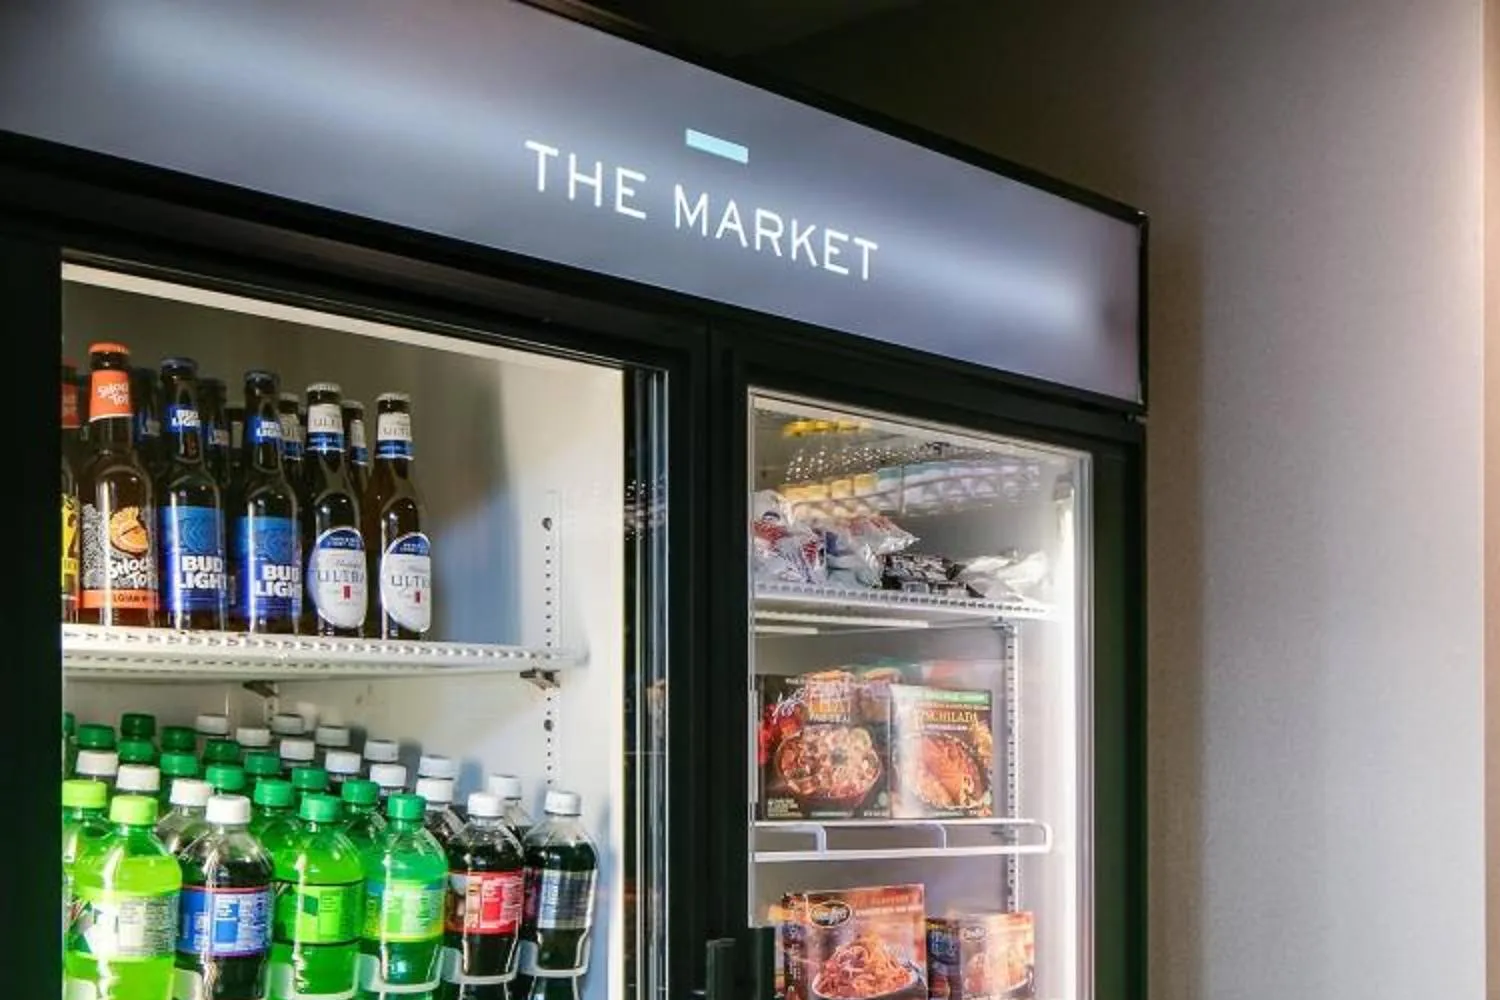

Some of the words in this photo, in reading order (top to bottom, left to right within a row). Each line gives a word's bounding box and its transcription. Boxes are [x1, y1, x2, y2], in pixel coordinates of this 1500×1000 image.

[525, 139, 647, 219] THE
[673, 184, 879, 281] MARKET
[181, 555, 223, 572] BUD
